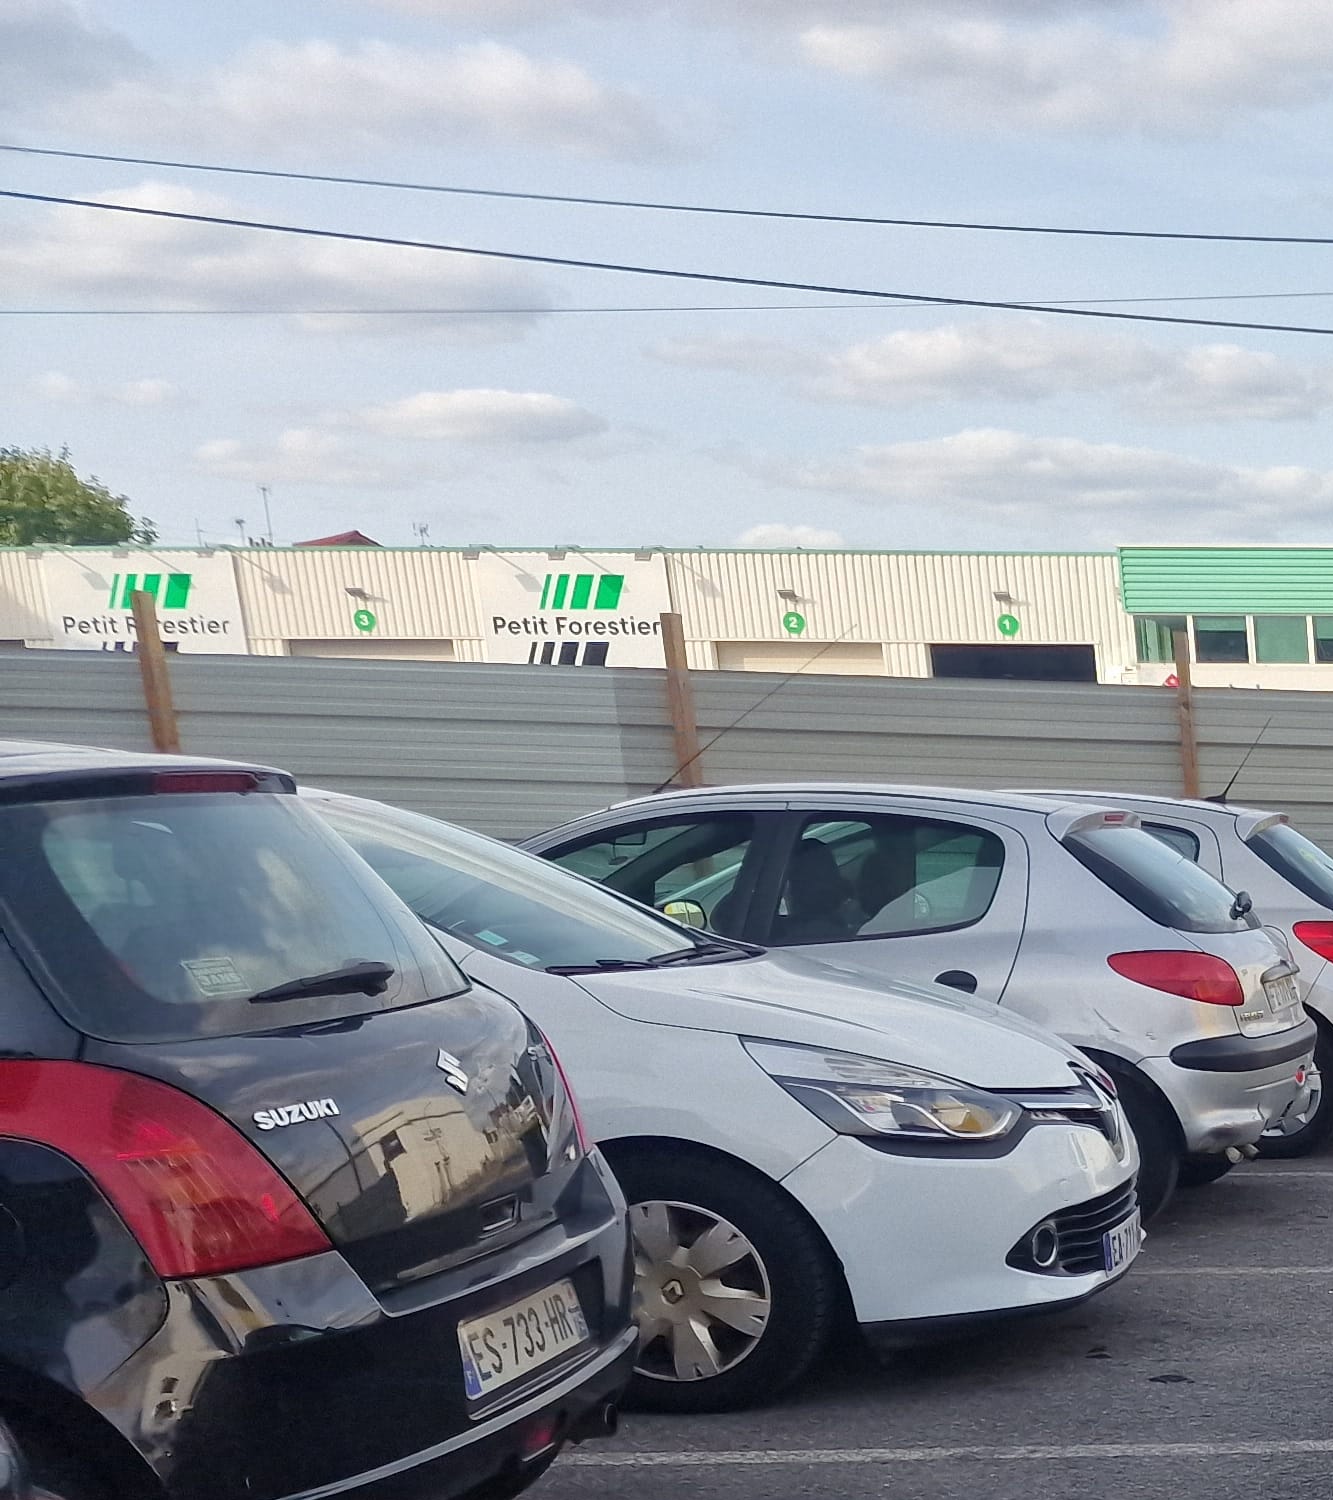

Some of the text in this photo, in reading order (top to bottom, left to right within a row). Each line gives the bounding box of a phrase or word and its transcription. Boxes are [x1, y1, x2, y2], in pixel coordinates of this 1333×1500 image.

[63, 615, 231, 635] Petit Festier
[359, 614, 369, 627] 3
[493, 615, 660, 636] Petit Forestier
[788, 616, 798, 629] 2
[253, 1098, 340, 1130] SUZUKI
[468, 1294, 574, 1381] ES-733-HR
